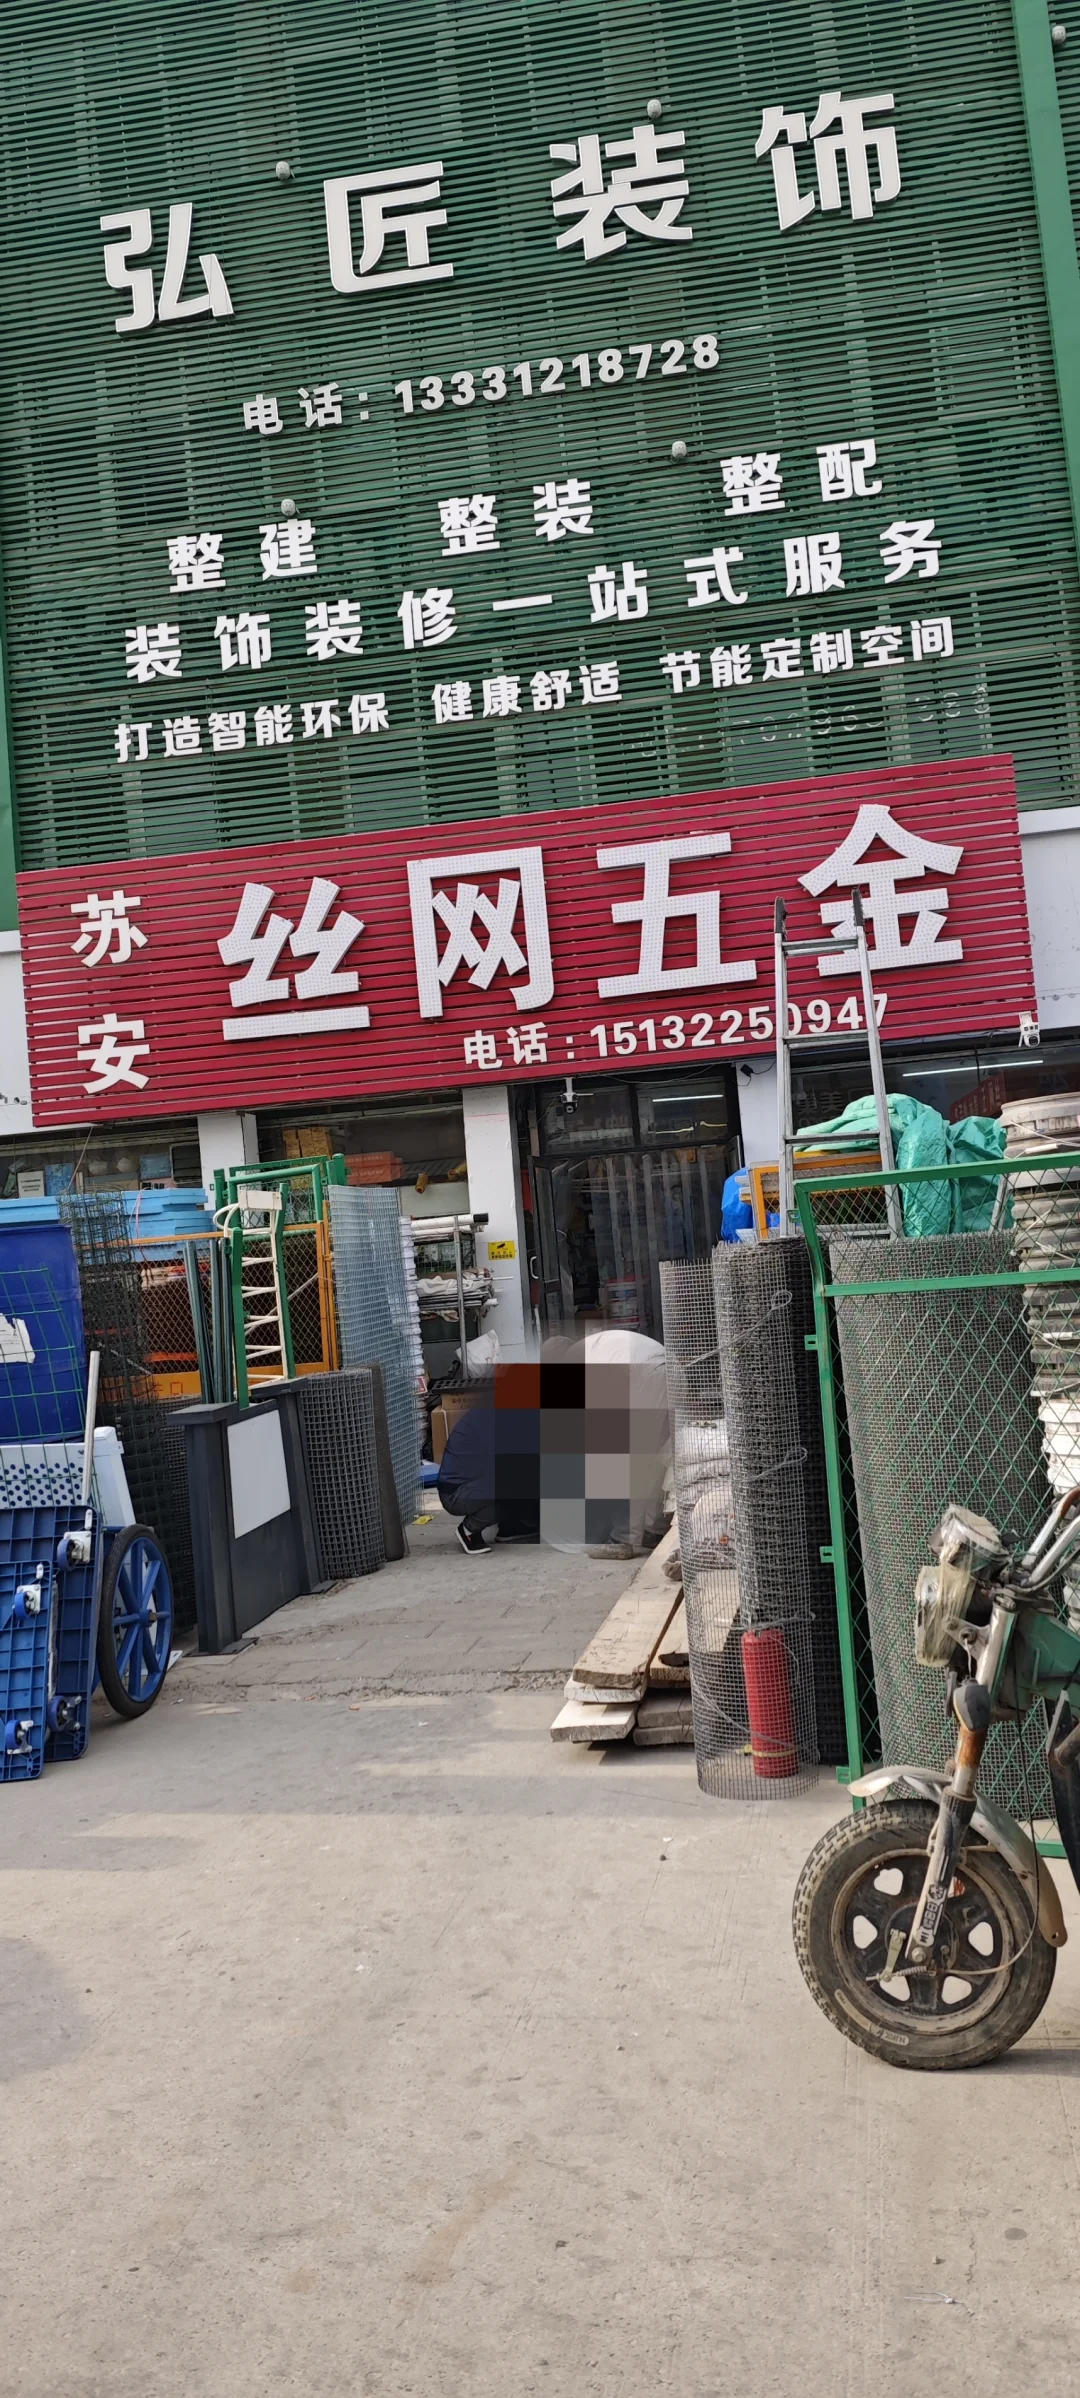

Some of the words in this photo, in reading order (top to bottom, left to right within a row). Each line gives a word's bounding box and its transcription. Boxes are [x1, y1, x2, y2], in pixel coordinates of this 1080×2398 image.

[99, 91, 903, 333] 弘匠装饰
[242, 332, 721, 436] 电话：13331218728
[166, 518, 319, 593] 整建
[437, 478, 595, 557] 整装
[719, 438, 884, 516] 整配
[124, 519, 943, 684] 装饰装修一站式服务
[113, 692, 390, 763] 打造智能环保
[430, 661, 622, 724] 健康舒适
[660, 616, 956, 694] 节能定制空间
[71, 890, 150, 1094] 苏安
[217, 804, 965, 1042] 丝网五金
